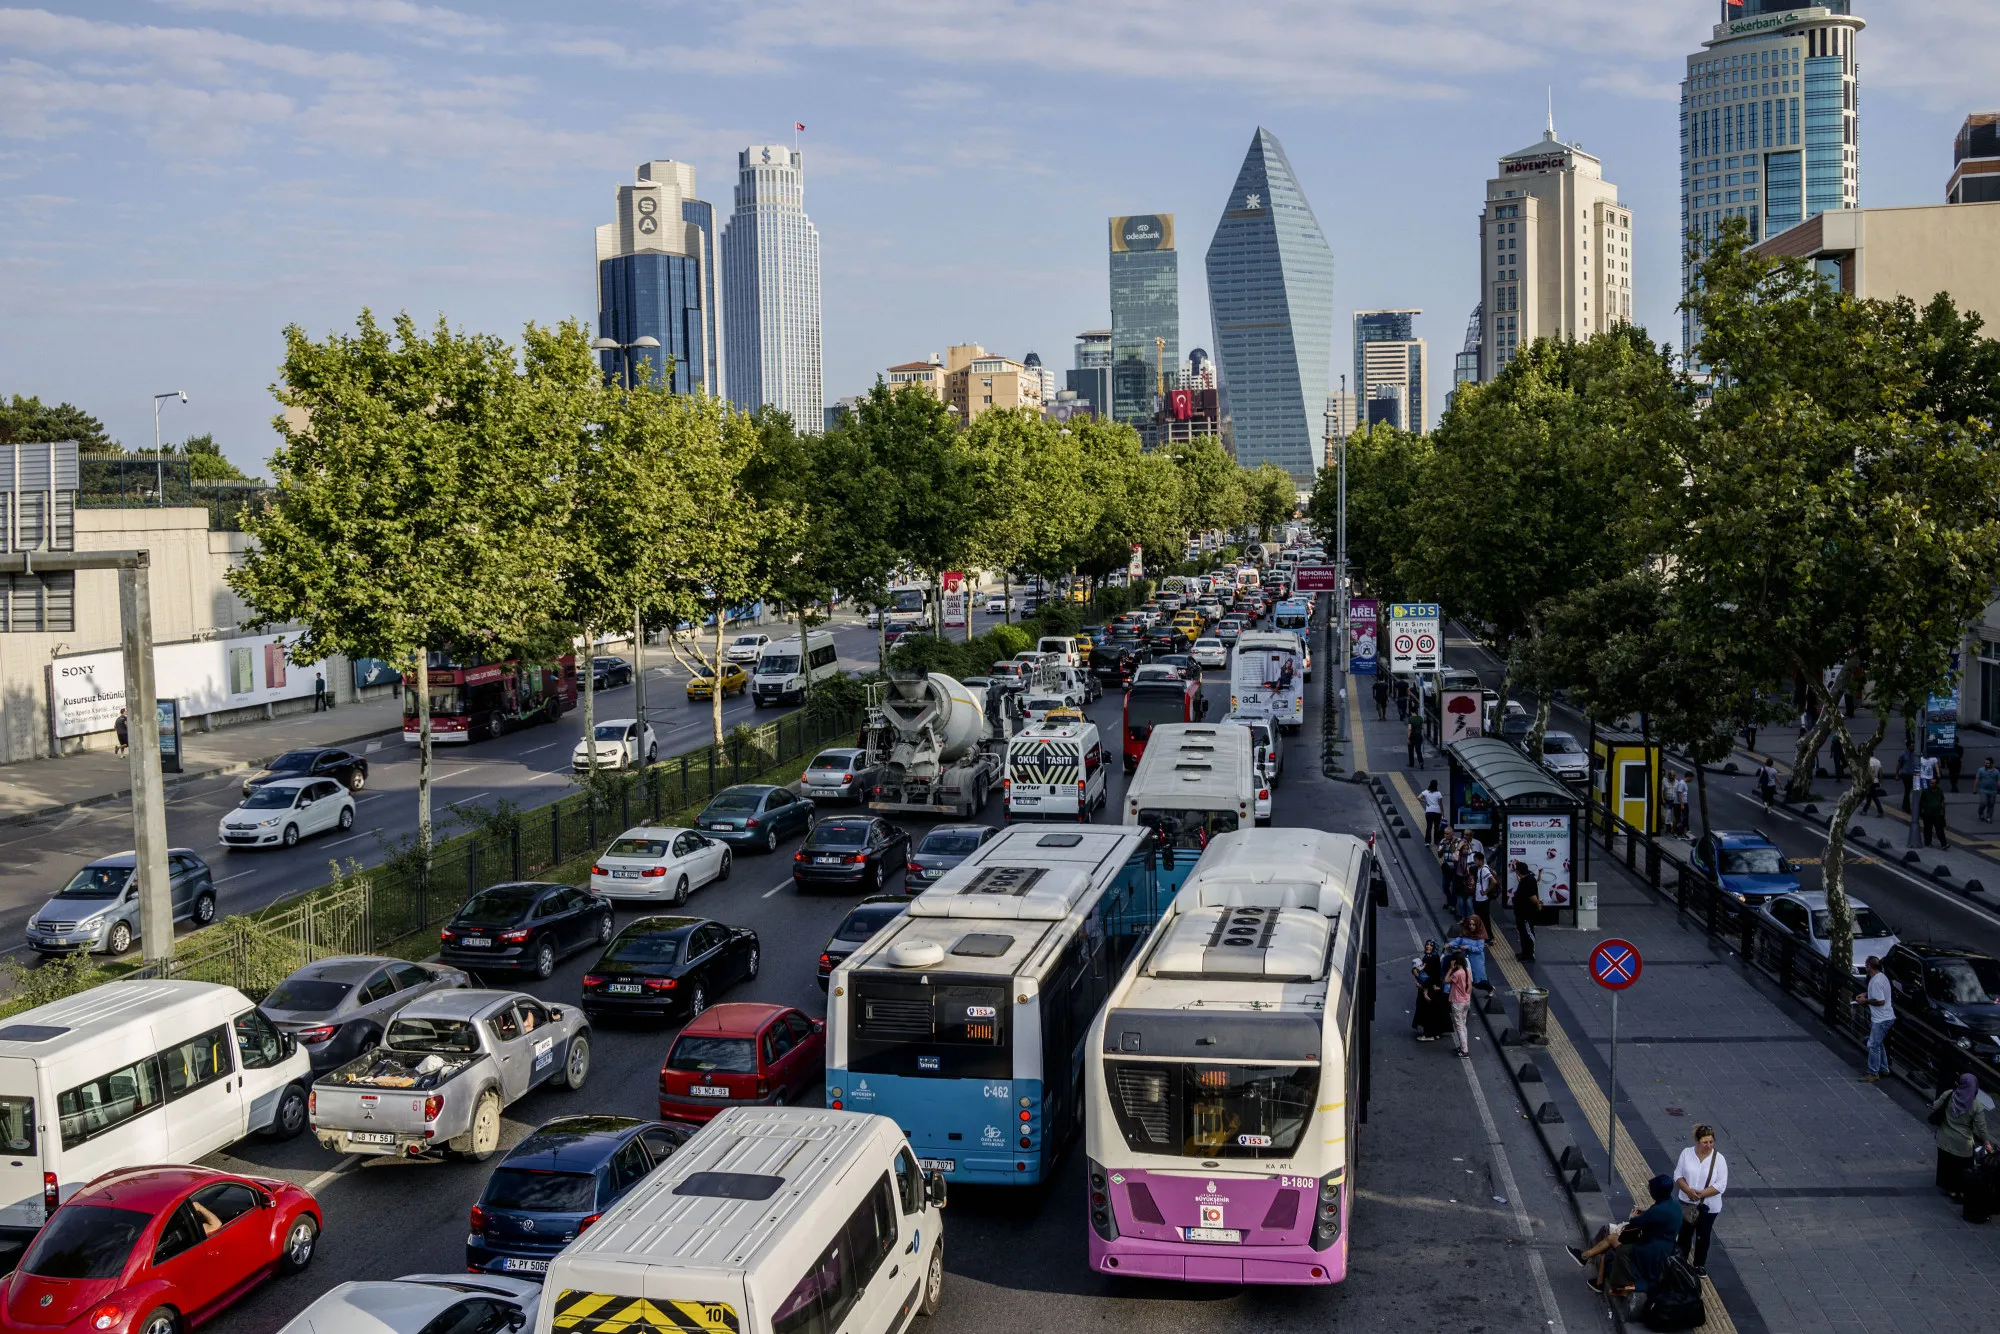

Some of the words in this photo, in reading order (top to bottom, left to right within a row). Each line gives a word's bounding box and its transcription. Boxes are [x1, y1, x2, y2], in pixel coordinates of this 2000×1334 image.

[1505, 158, 1565, 174] MÖVENPICK
[1126, 231, 1160, 240] odeabank
[1351, 608, 1376, 617] AREL
[1409, 607, 1435, 616] EDS
[1399, 640, 1410, 648] 70
[1420, 640, 1431, 648] 60
[62, 665, 95, 677] SONY
[63, 695, 96, 706] Kusursuz
[1017, 756, 1039, 764] OKUL
[1549, 819, 1561, 828] 25
[984, 1086, 1009, 1098] C-462
[412, 1100, 421, 1111] 61
[379, 1135, 392, 1143] 561
[924, 1160, 933, 1168] UV
[937, 1161, 953, 1169] 7071
[1282, 1177, 1314, 1188] B-1808
[507, 1259, 515, 1268] 34
[519, 1260, 528, 1270] PY
[530, 1262, 548, 1271] 5066
[706, 1308, 722, 1322] 10
